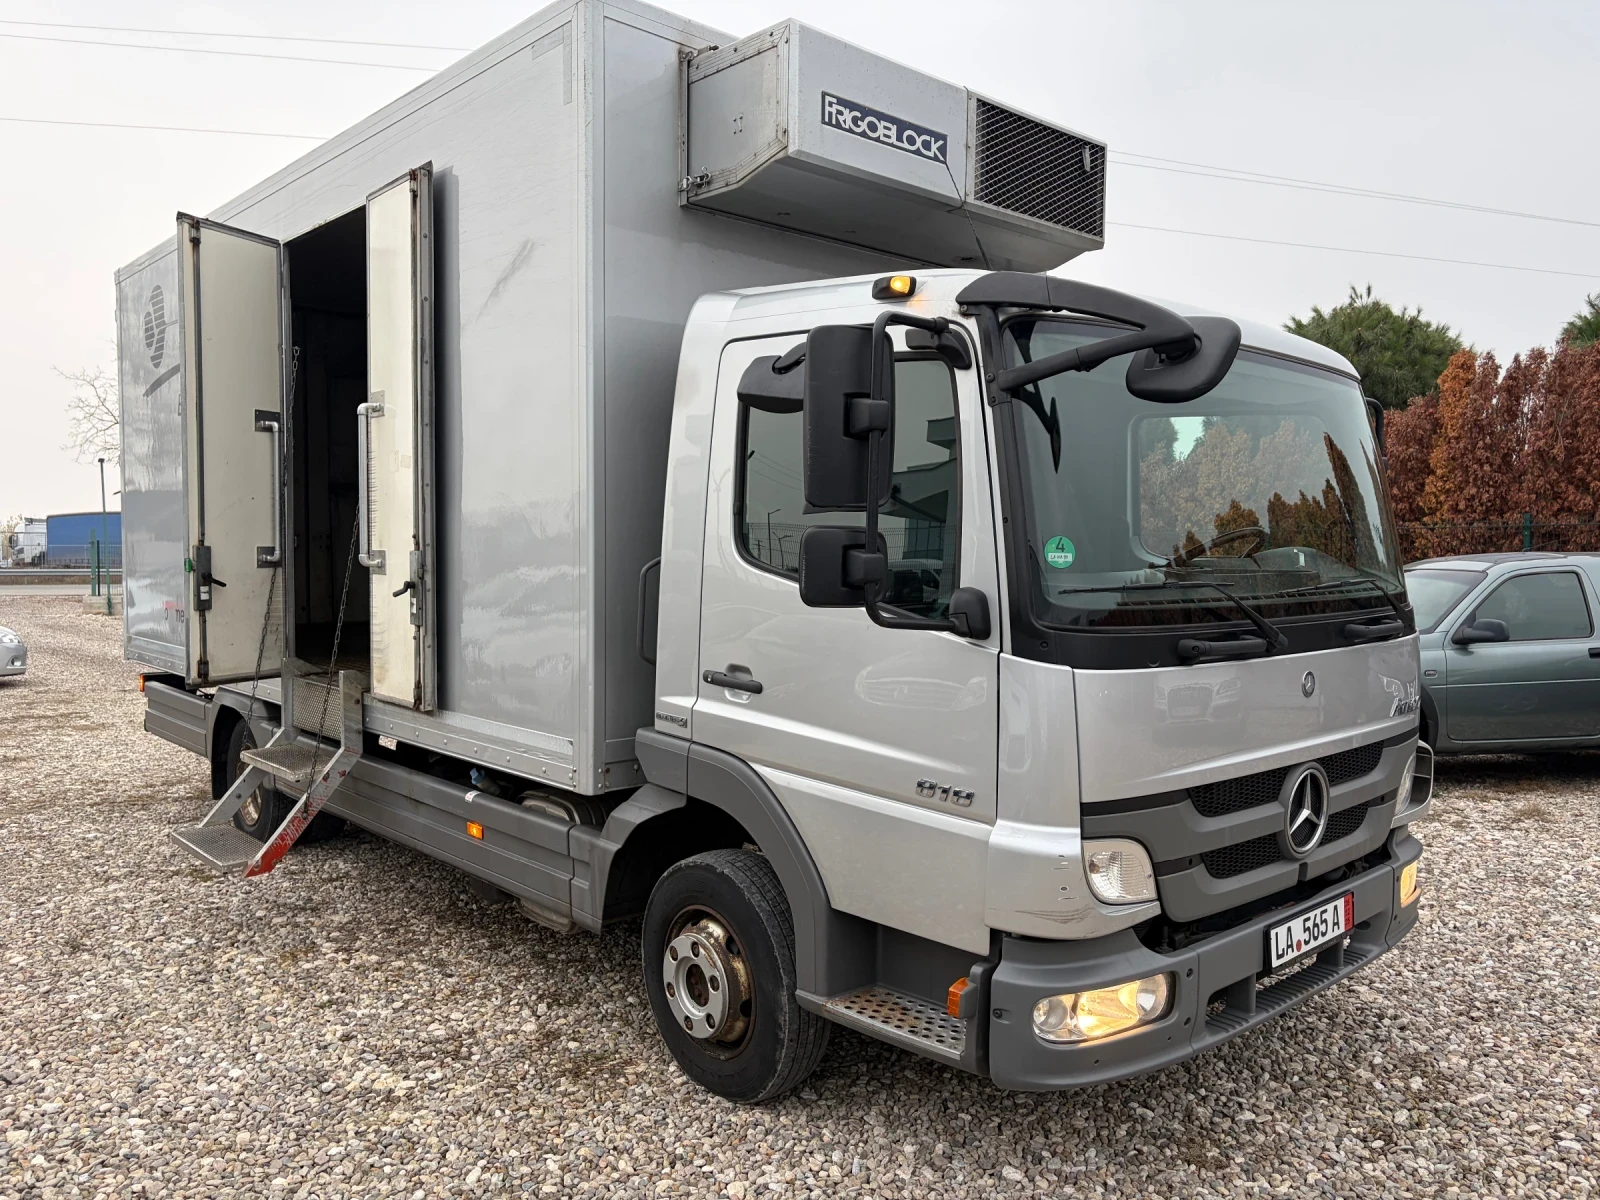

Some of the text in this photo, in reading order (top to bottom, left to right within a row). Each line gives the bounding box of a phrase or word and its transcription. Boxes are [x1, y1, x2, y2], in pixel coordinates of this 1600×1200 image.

[824, 95, 945, 162] FRIGOBLOCK
[1055, 536, 1066, 553] 4
[915, 778, 974, 807] 818
[1275, 925, 1295, 960] LA
[1302, 908, 1329, 946] 565
[1331, 904, 1340, 933] A
